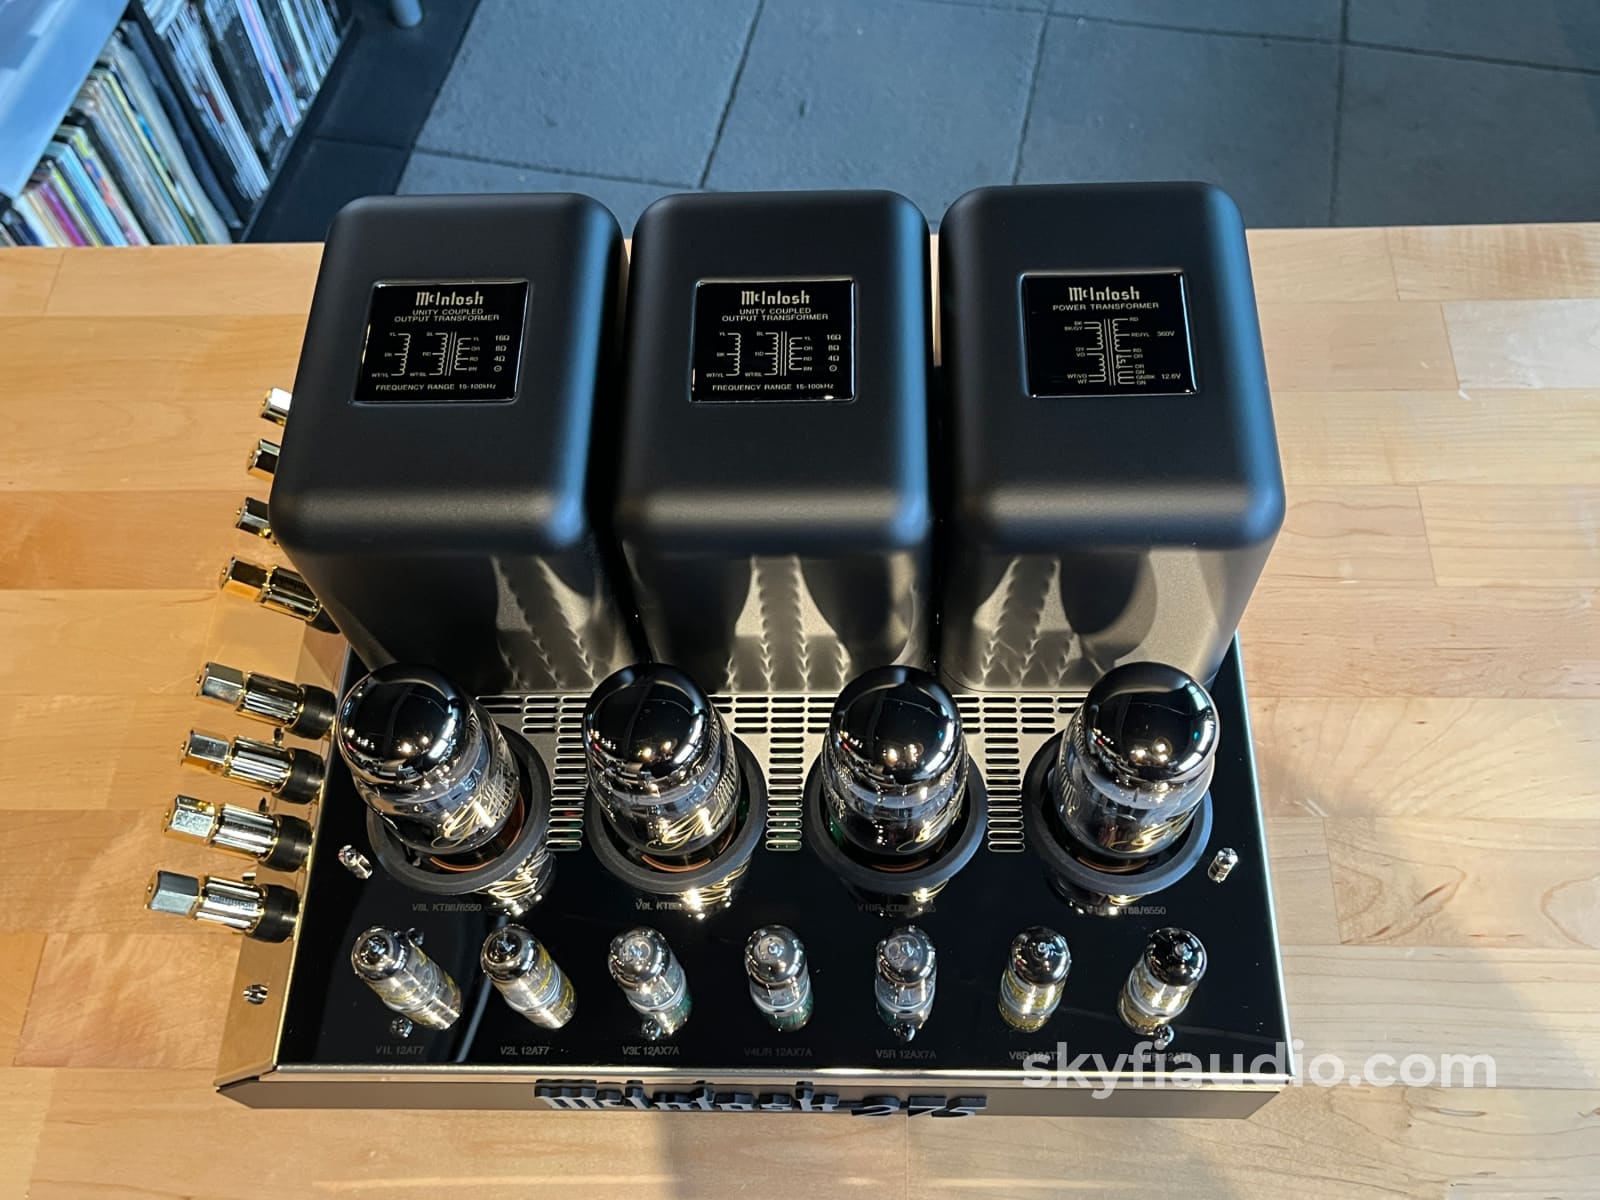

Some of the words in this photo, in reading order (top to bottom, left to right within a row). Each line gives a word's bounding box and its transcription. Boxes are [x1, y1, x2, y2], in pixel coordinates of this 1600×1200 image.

[415, 291, 484, 306] McIntosh
[741, 290, 811, 306] McIntosh
[1068, 286, 1140, 301] McIntosh
[434, 314, 500, 322] TRANSFORMER
[396, 1046, 424, 1055] 12AT7
[500, 1046, 518, 1056] V2L
[521, 1046, 550, 1056] 12AT7
[642, 1046, 680, 1056] 12AX7A
[774, 1047, 812, 1057] 12AX7A
[899, 1048, 937, 1059] 12AX7A
[535, 1079, 839, 1111] McIntosh
